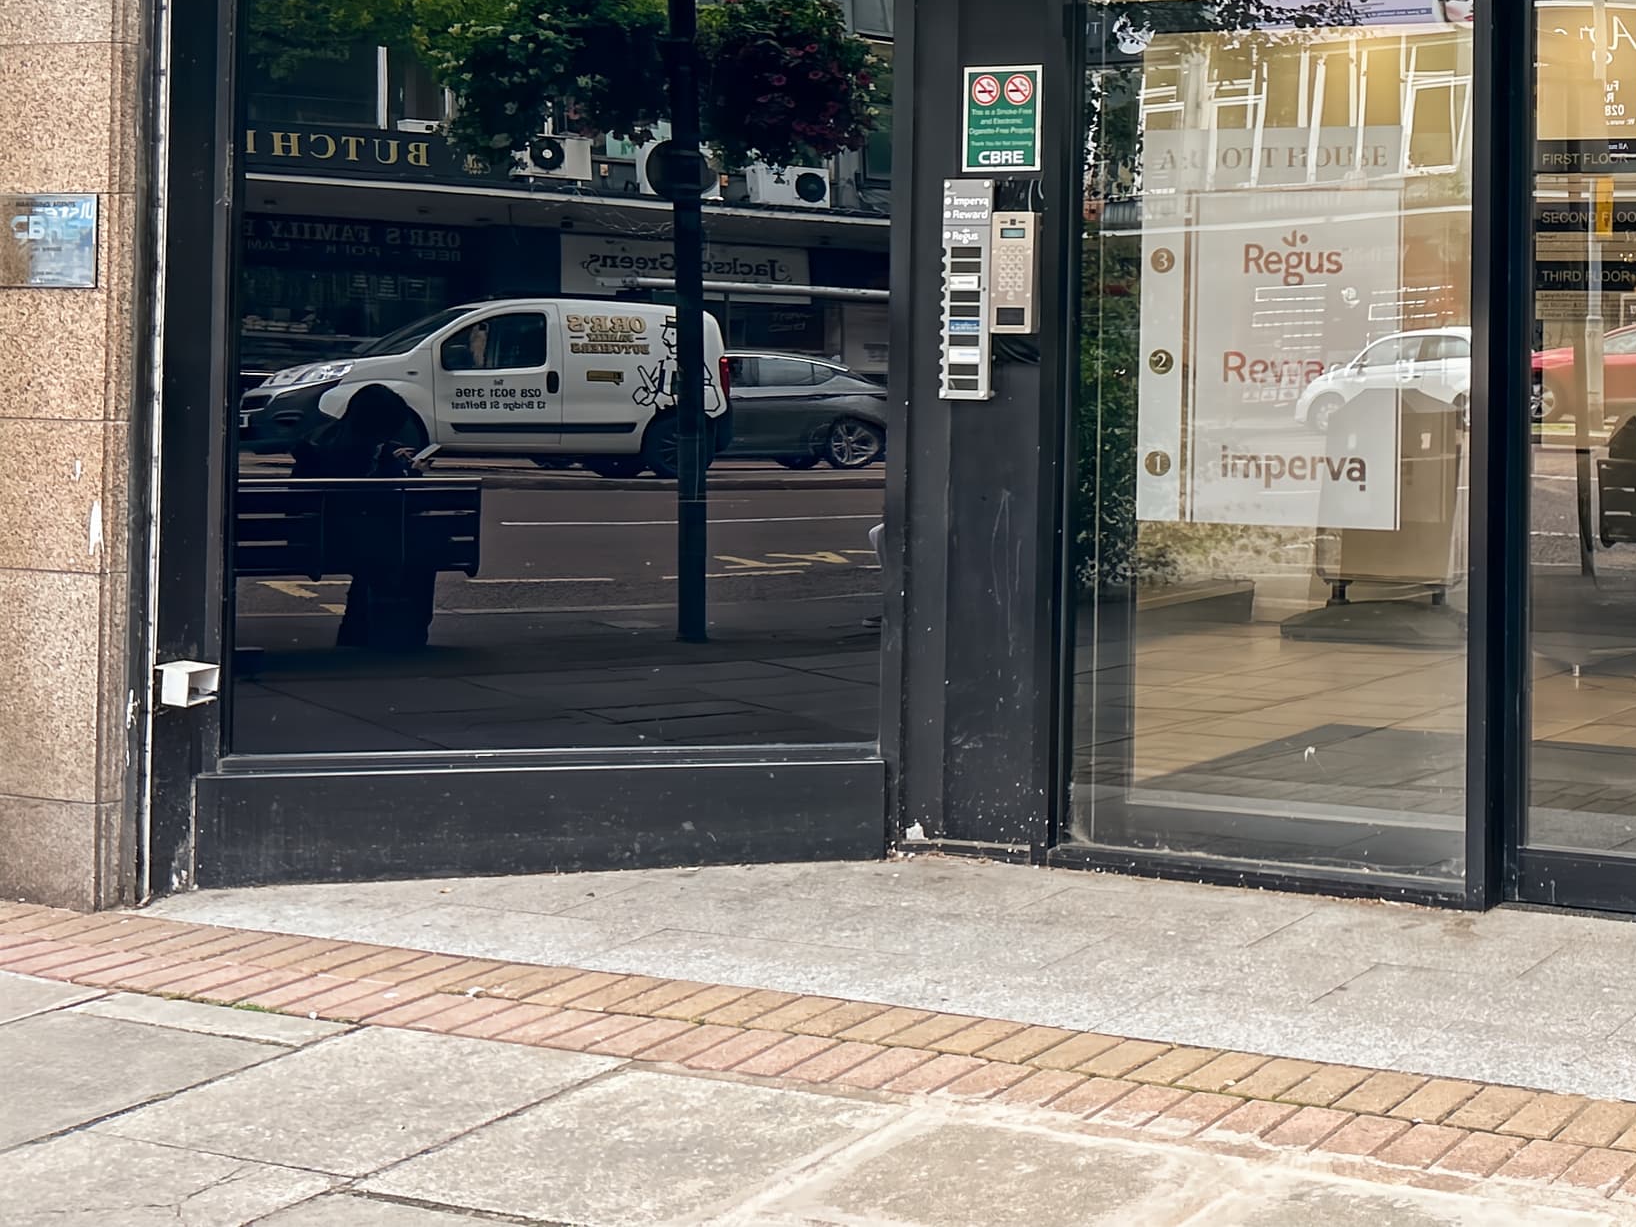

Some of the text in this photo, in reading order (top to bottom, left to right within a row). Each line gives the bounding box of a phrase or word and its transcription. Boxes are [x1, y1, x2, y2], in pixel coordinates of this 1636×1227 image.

[977, 150, 1025, 165] CBRE
[1542, 152, 1629, 166] FIRST FLOOR
[952, 209, 988, 220] Reward
[1542, 211, 1597, 224] SECOND
[952, 230, 980, 244] Regus
[1243, 243, 1344, 286] Regus
[1542, 270, 1582, 283] THIRD
[1223, 350, 1330, 385] Rewa
[1220, 444, 1367, 491] imperva
